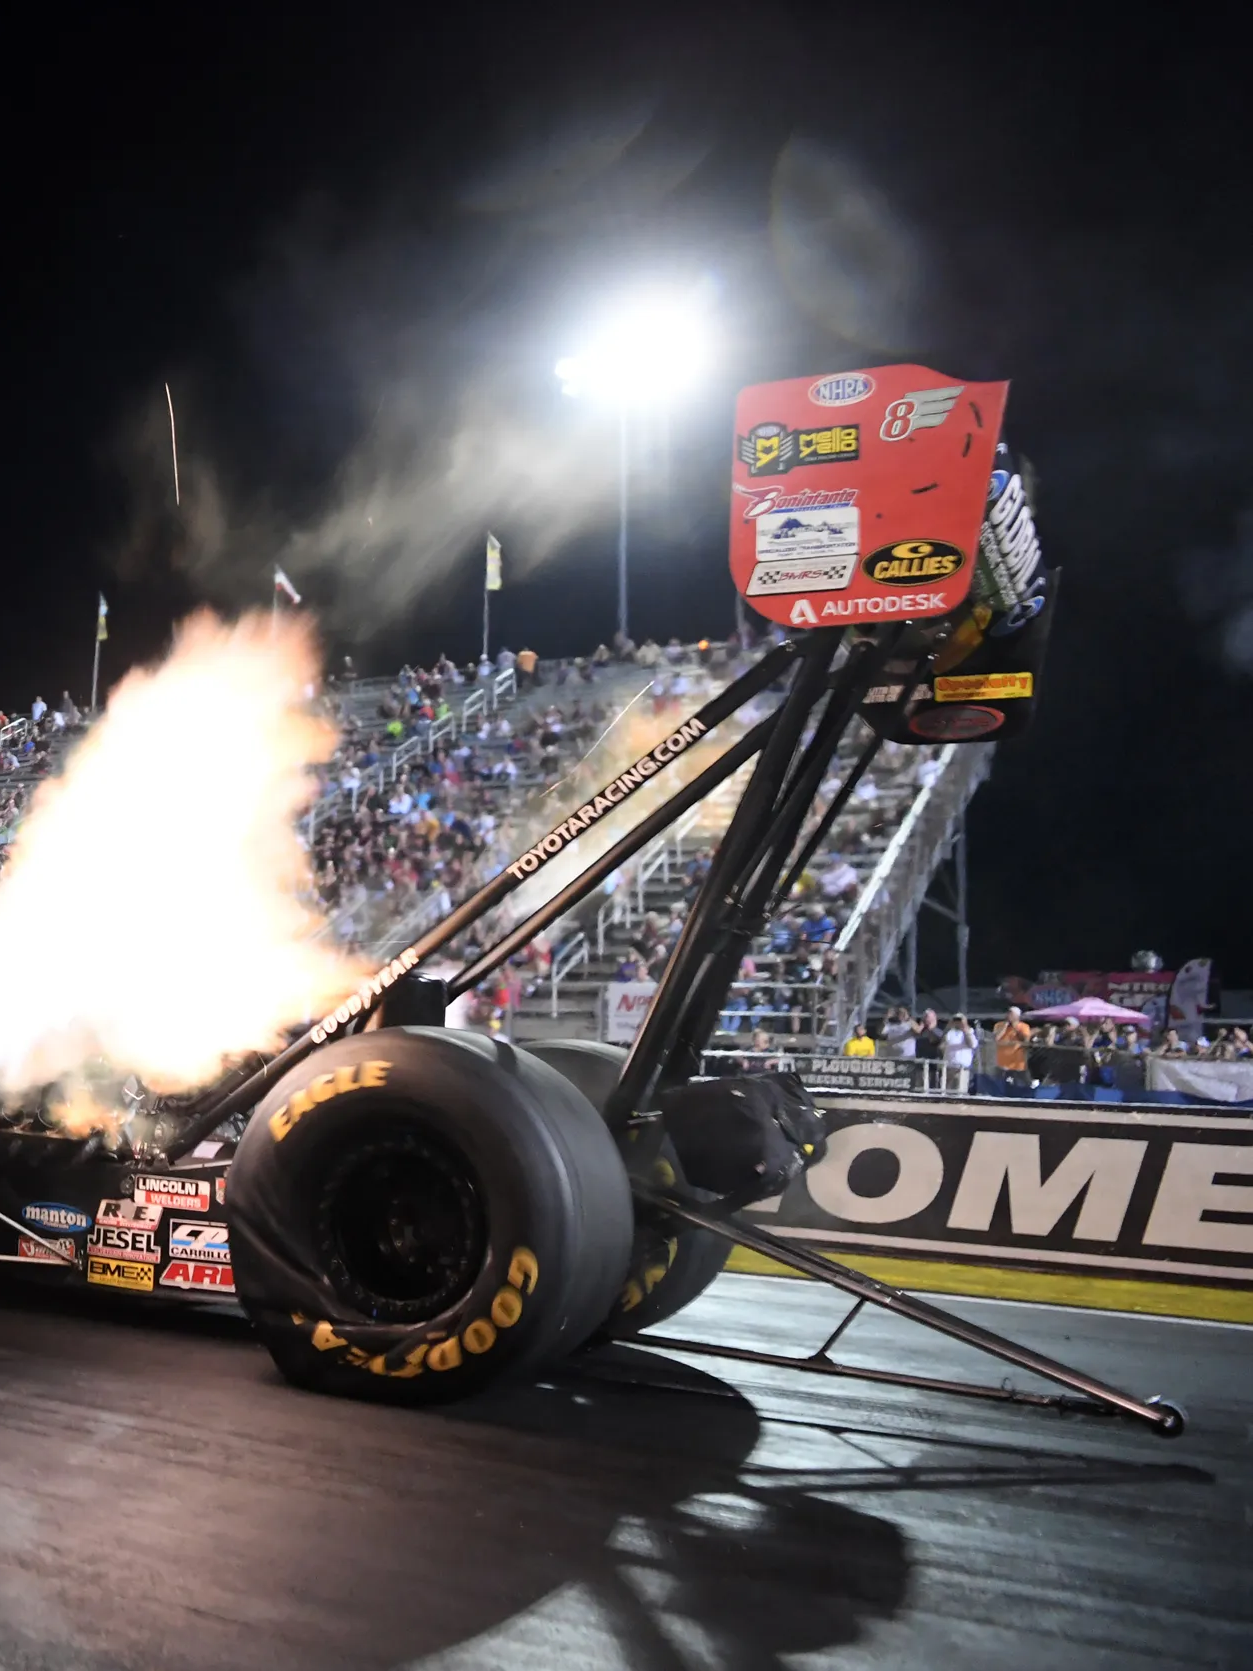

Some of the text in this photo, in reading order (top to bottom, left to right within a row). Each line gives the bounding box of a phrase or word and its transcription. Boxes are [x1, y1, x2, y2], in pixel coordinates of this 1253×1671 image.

[819, 377, 865, 400] NHRA
[880, 398, 917, 441] 8
[990, 474, 1041, 593] GLOBAL
[873, 555, 958, 579] CALLIES
[821, 593, 948, 616] AUTODESK
[506, 718, 707, 880] TOYOTARACING.COM
[310, 947, 420, 1044] GOODYEAR
[858, 1076, 911, 1089] SERVICE
[268, 1060, 395, 1142] EAGLE
[139, 1178, 196, 1195] LINCOLN
[743, 1122, 1253, 1255] OME
[150, 1193, 201, 1208] WELDERS
[25, 1205, 87, 1227] manton
[88, 1228, 156, 1253] JESEL
